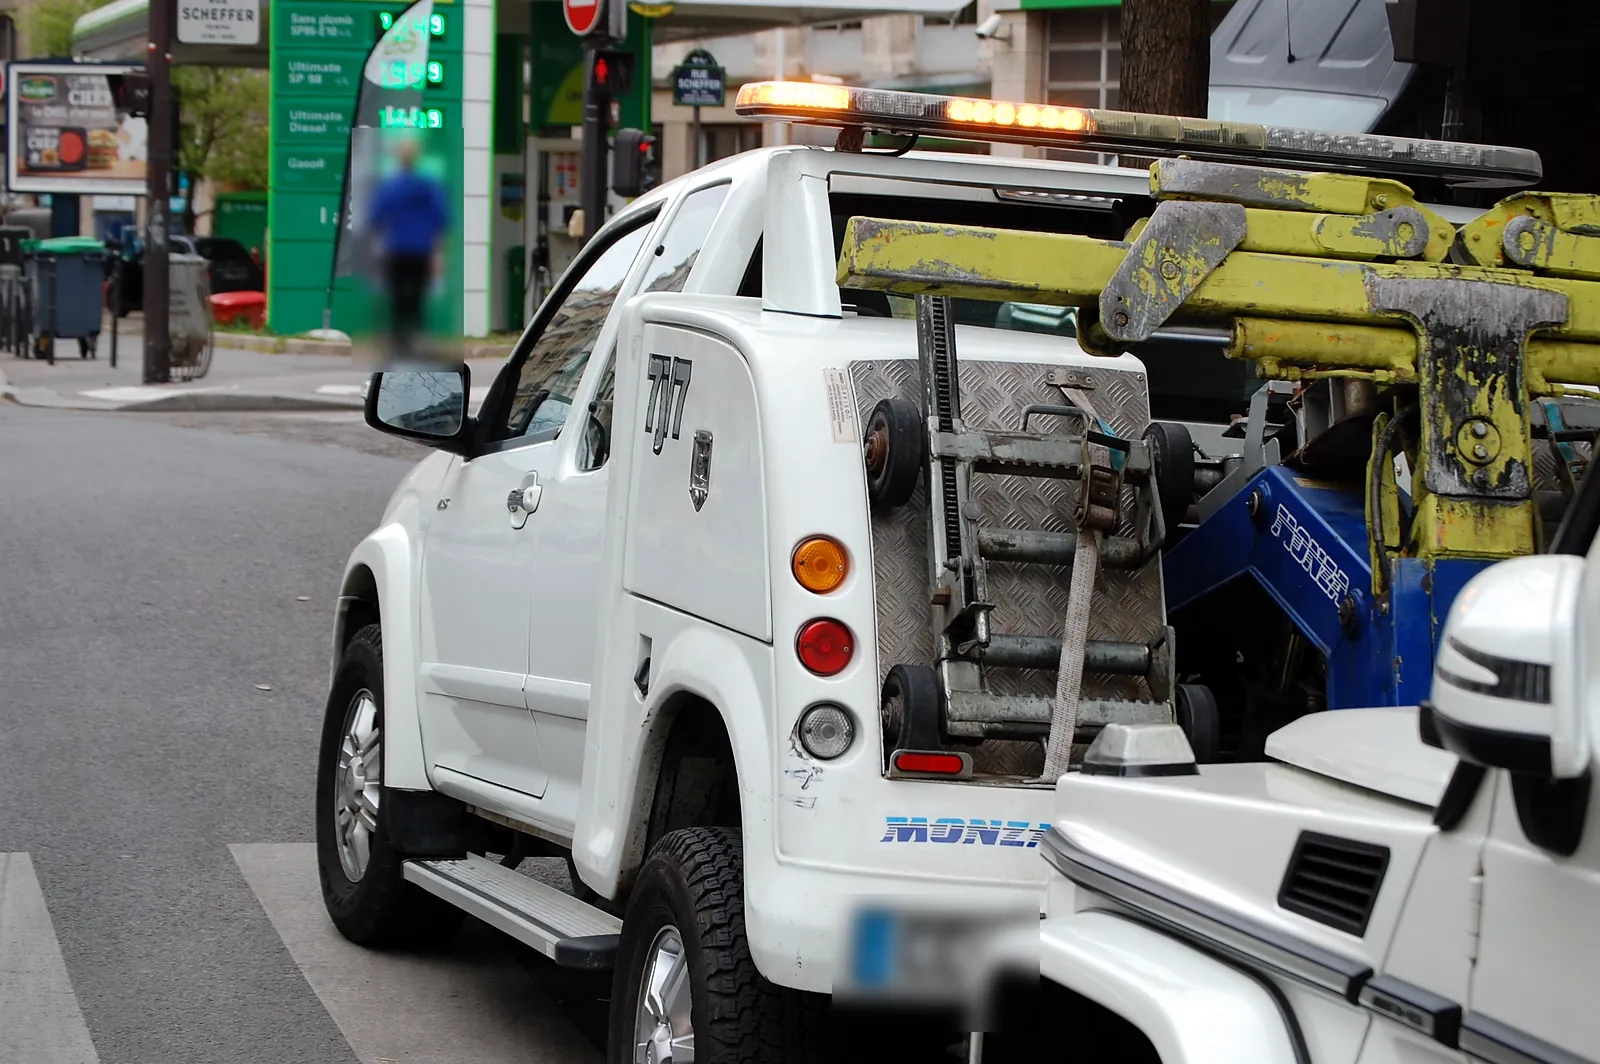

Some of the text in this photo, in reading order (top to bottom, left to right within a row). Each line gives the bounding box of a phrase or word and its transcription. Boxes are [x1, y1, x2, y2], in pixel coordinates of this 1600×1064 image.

[182, 7, 254, 21] SCHEFFER
[288, 61, 342, 73] Ultimate
[690, 69, 709, 79] RUE
[289, 110, 342, 122] Ultimate
[289, 121, 327, 133] Diesel
[288, 157, 325, 169] Gasoil
